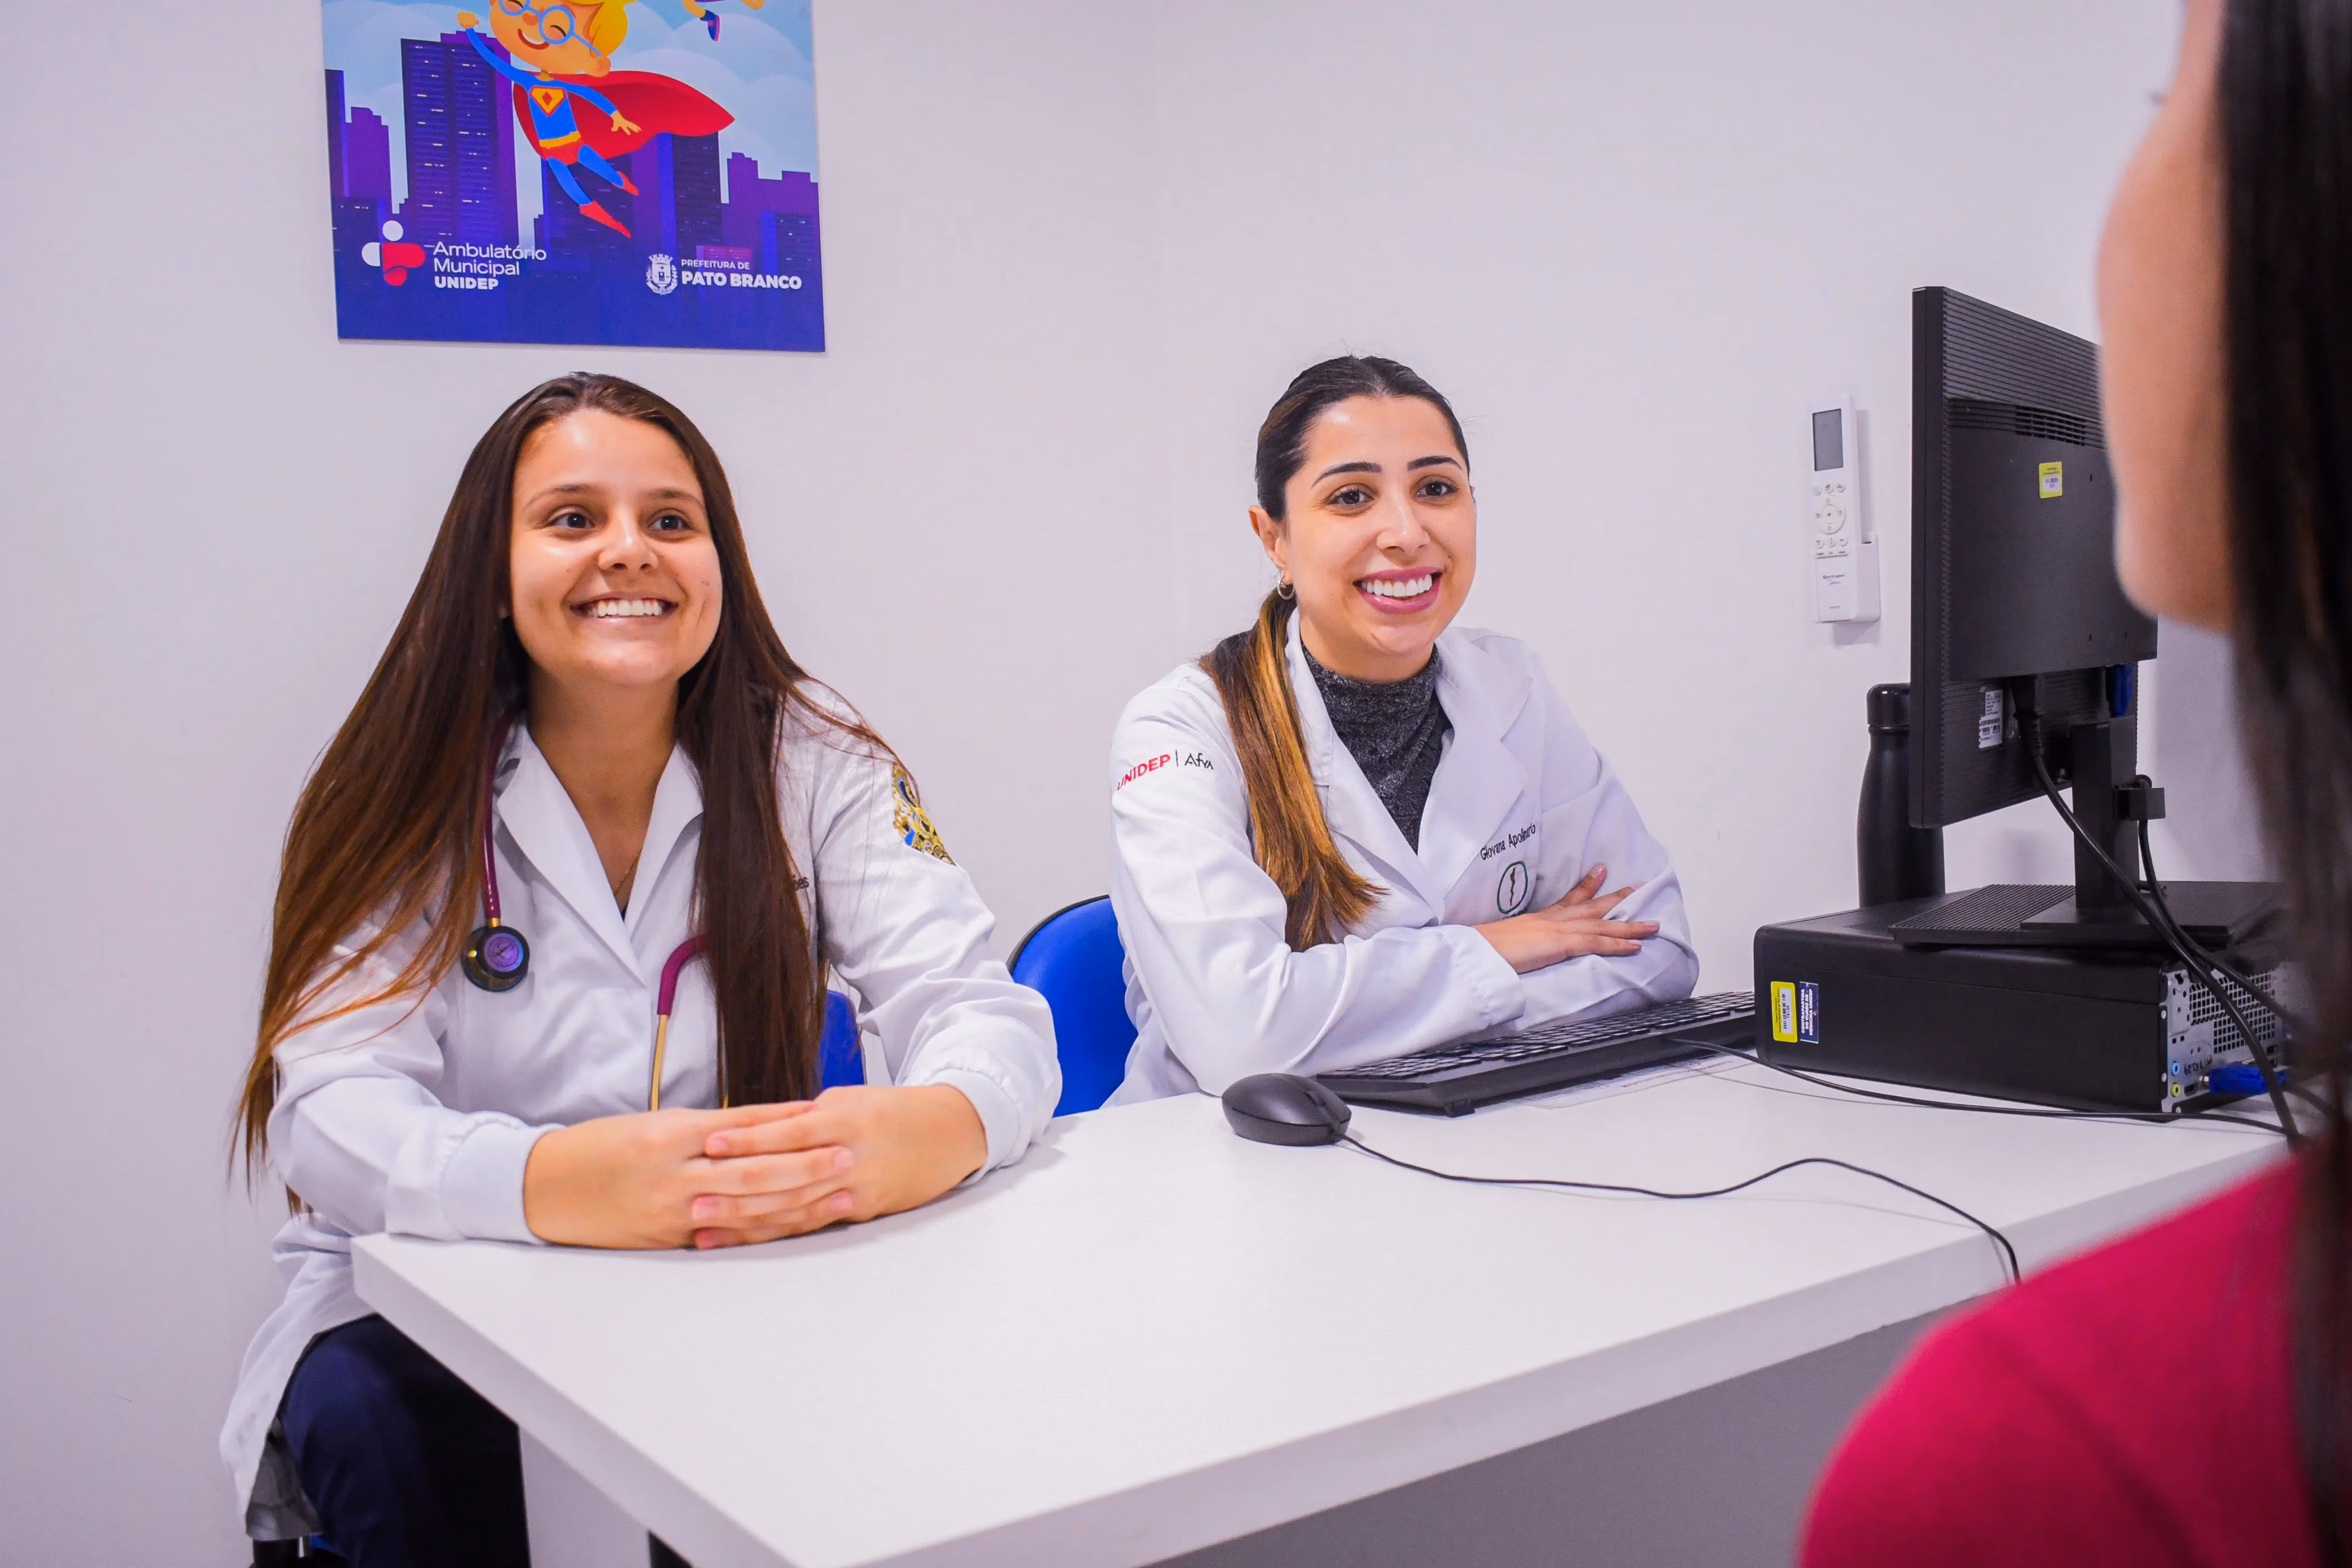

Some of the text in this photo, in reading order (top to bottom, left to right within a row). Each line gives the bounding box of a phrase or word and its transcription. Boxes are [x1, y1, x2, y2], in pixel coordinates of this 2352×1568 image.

[433, 241, 547, 261] Ambulatório
[434, 257, 520, 277] Municipal
[681, 259, 736, 269] PREFEITURA
[434, 276, 499, 290] UNIDEP
[681, 271, 803, 289] PATO BRANCO
[1116, 754, 1171, 791] UNIDEP
[1480, 840, 1507, 861] Giovana
